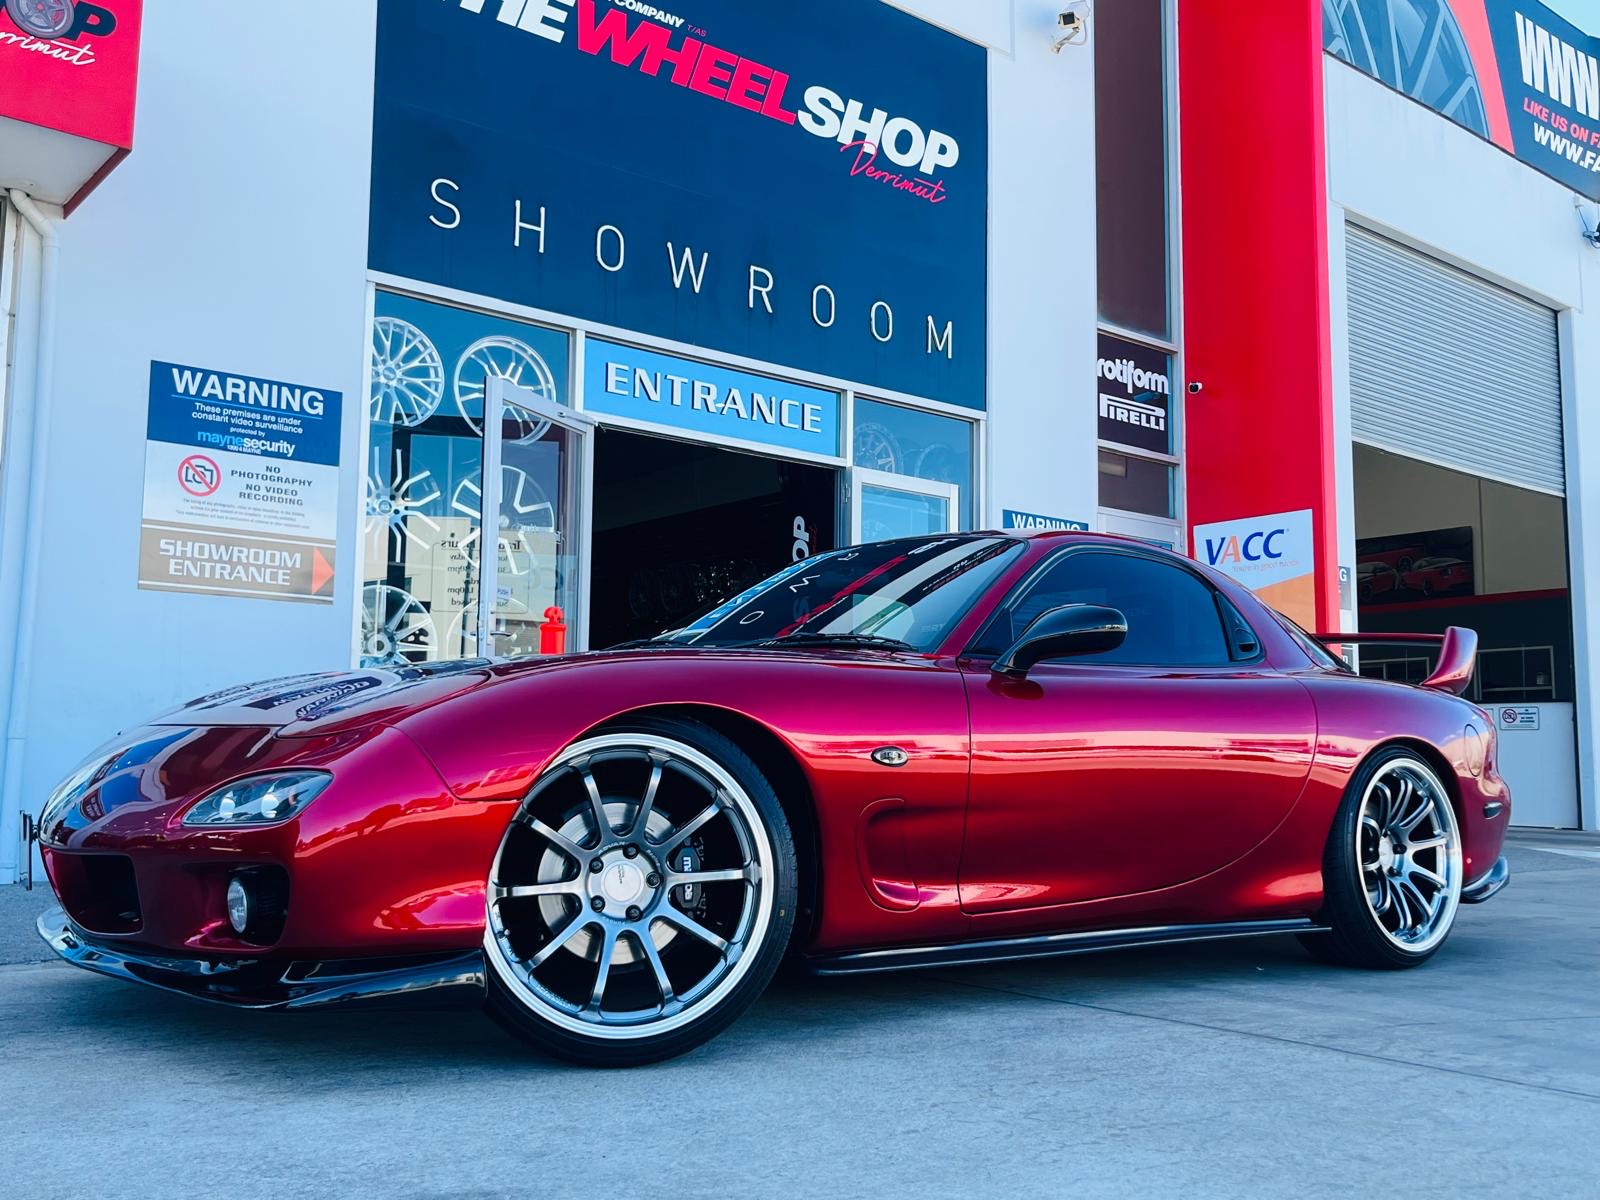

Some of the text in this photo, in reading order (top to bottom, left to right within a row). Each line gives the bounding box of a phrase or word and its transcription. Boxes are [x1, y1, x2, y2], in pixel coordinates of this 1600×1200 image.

[577, 0, 797, 125] WHEEL
[797, 85, 960, 175] SHOP
[1523, 97, 1549, 123] LIKE
[1551, 112, 1568, 133] US
[1570, 123, 1589, 143] ON
[429, 178, 953, 359] SHOWROOM
[1097, 358, 1169, 394] rotiform
[172, 367, 325, 416] WARNING
[605, 361, 823, 434] ENTRANCE
[192, 411, 303, 434] constant video surveillance
[195, 402, 302, 426] These premises are under
[1099, 392, 1166, 431] PIRELLI
[197, 431, 296, 457] maynesecurity
[229, 426, 266, 438] protected by
[230, 470, 313, 487] PHOTOGRAPHY
[266, 465, 281, 474] NO
[239, 491, 304, 506] RECORDING
[245, 483, 298, 497] NO VIDEO
[159, 539, 302, 568] SHOWROOM
[1205, 529, 1285, 566] VACC
[169, 559, 291, 586] ENTRANCE
